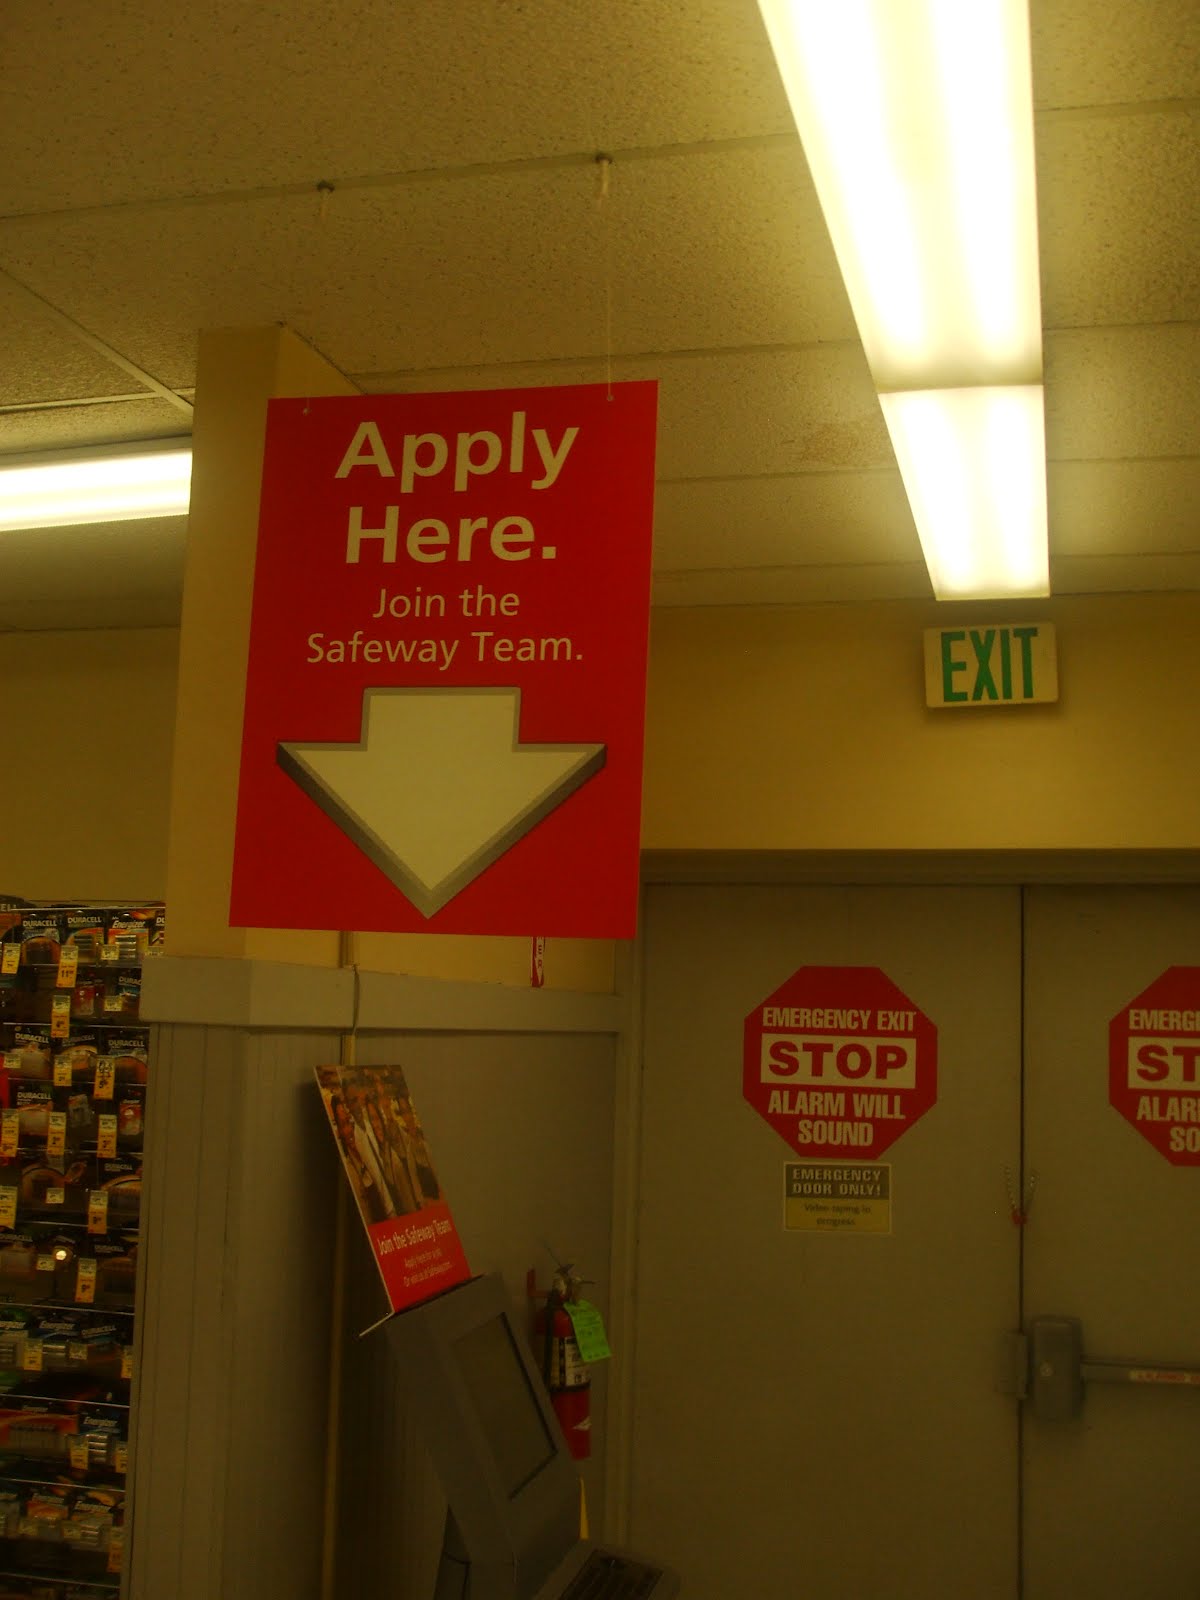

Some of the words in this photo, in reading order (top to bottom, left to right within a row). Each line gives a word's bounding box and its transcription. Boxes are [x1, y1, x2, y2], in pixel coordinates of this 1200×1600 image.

[334, 411, 580, 494] Apply
[344, 505, 558, 564] Here.
[372, 587, 446, 618] Join
[458, 584, 521, 617] the
[306, 630, 460, 671] Safeway
[470, 630, 585, 662] Team.
[941, 627, 1038, 703] EXIT
[22, 919, 58, 928] DURACELL
[67, 916, 102, 925] DURACELL
[112, 920, 146, 930] Energizer
[762, 1006, 872, 1030] EMERGENCY
[876, 1010, 917, 1032] EXIT
[15, 1032, 50, 1044] DURACELL
[108, 1039, 145, 1047] DURACELL
[768, 1041, 908, 1079] STOP
[16, 1092, 52, 1100] DURACELL
[767, 1090, 846, 1118] ALARM
[852, 1093, 906, 1120] WILL
[1135, 1095, 1200, 1124] ALAR
[797, 1119, 874, 1147] SOUND
[792, 1168, 881, 1182] EMERGENCY
[792, 1183, 833, 1195] DOOR
[839, 1183, 881, 1196] ONLY!
[376, 1234, 395, 1256] Join
[392, 1231, 408, 1250] the
[405, 1224, 437, 1246] Safeway
